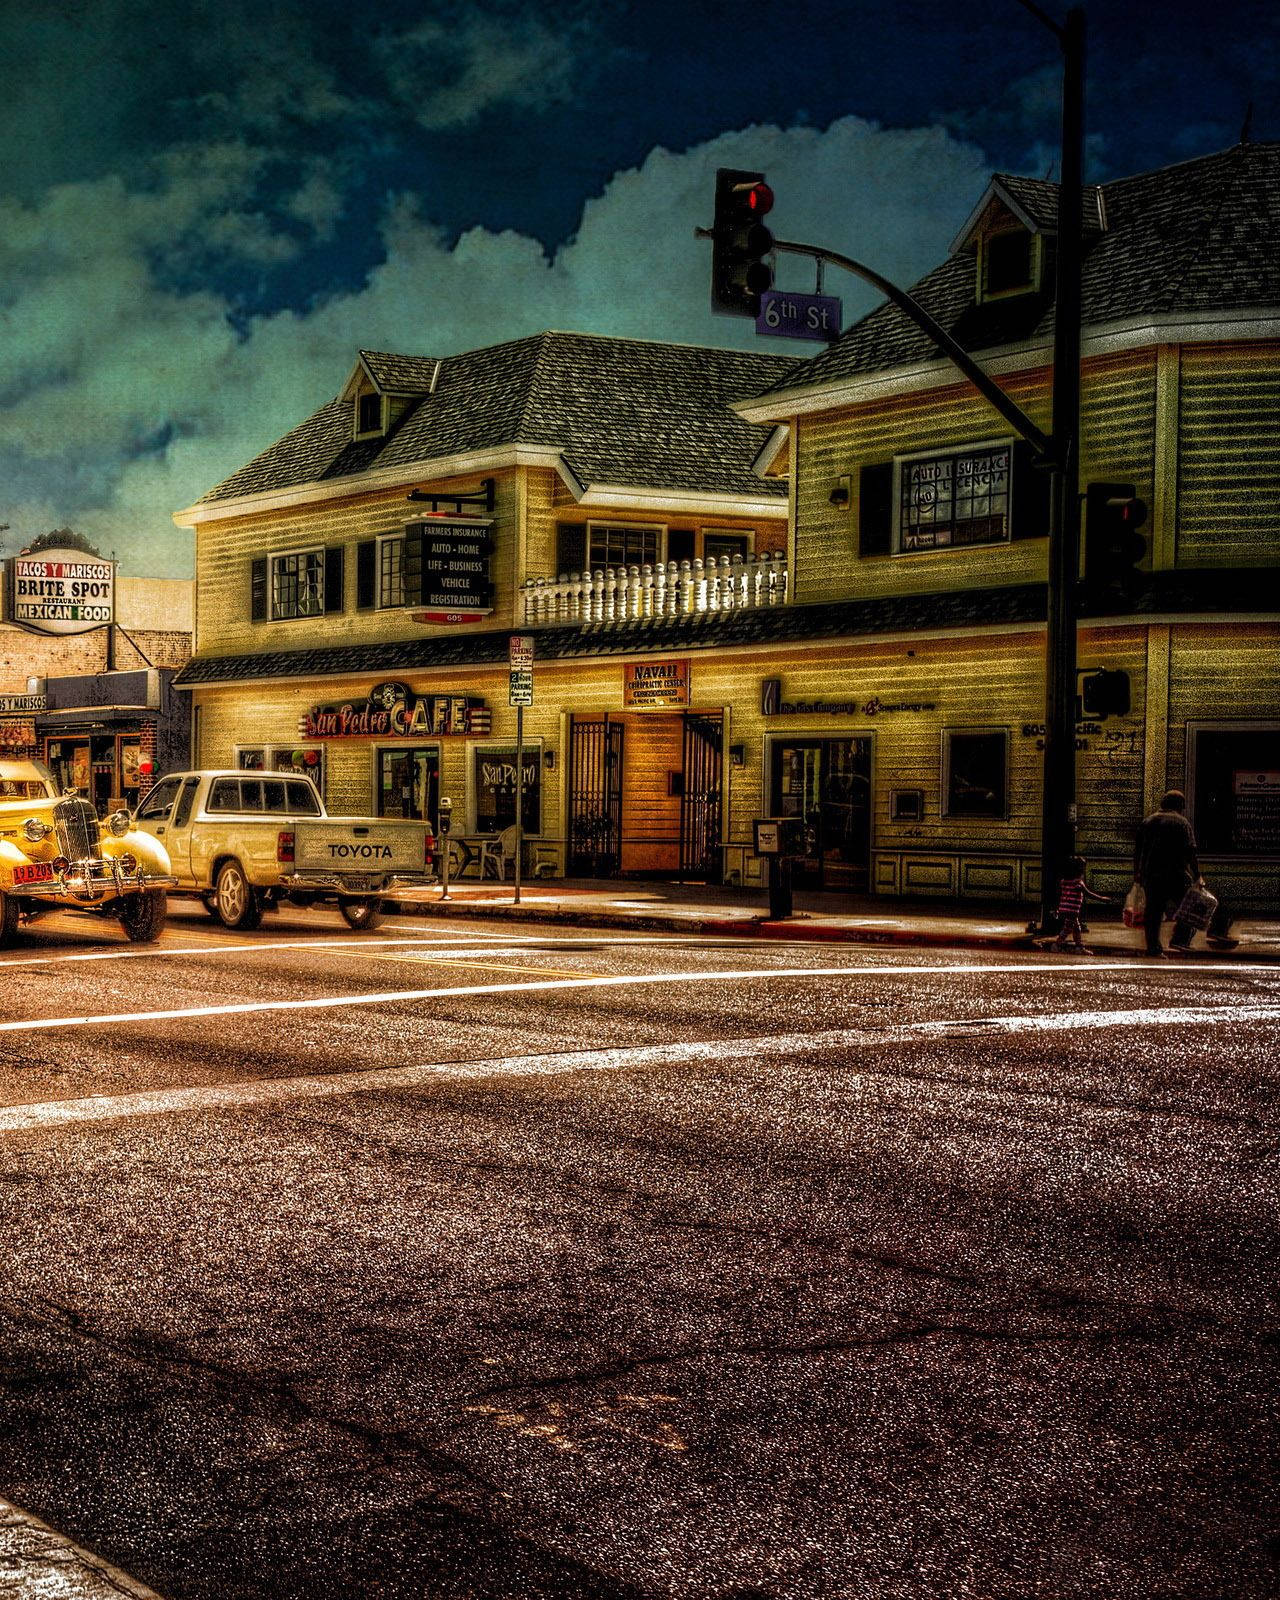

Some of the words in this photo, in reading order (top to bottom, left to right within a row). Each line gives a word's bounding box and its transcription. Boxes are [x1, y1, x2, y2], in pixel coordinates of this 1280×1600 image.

[765, 299, 797, 327] 6th
[807, 305, 829, 329] St
[913, 466, 941, 480] AUTO
[424, 526, 452, 536] FARMERS
[452, 528, 487, 538] INSURANCE
[431, 543, 451, 553] AUTO
[458, 544, 480, 554] HOME
[18, 562, 48, 577] TACOS
[51, 563, 59, 577] Y
[61, 564, 110, 579] MARISCOS
[428, 560, 442, 570] LIFE
[449, 561, 483, 572] BUSINESS
[17, 580, 65, 596] BRITE
[71, 582, 110, 598] SPOT
[441, 578, 471, 589] VEHICLE
[42, 597, 86, 605] RESTAURANT
[430, 594, 481, 605] REGISTRATION
[17, 604, 72, 619] MEXICAN
[77, 606, 110, 621] FOOD
[447, 614, 463, 622] 605
[511, 673, 518, 682] 2
[634, 664, 678, 680] NAVAH
[14, 697, 46, 710] MARISCOS
[389, 697, 469, 737] CAFE
[501, 763, 535, 787] Pero
[328, 845, 392, 858] TOYOTA
